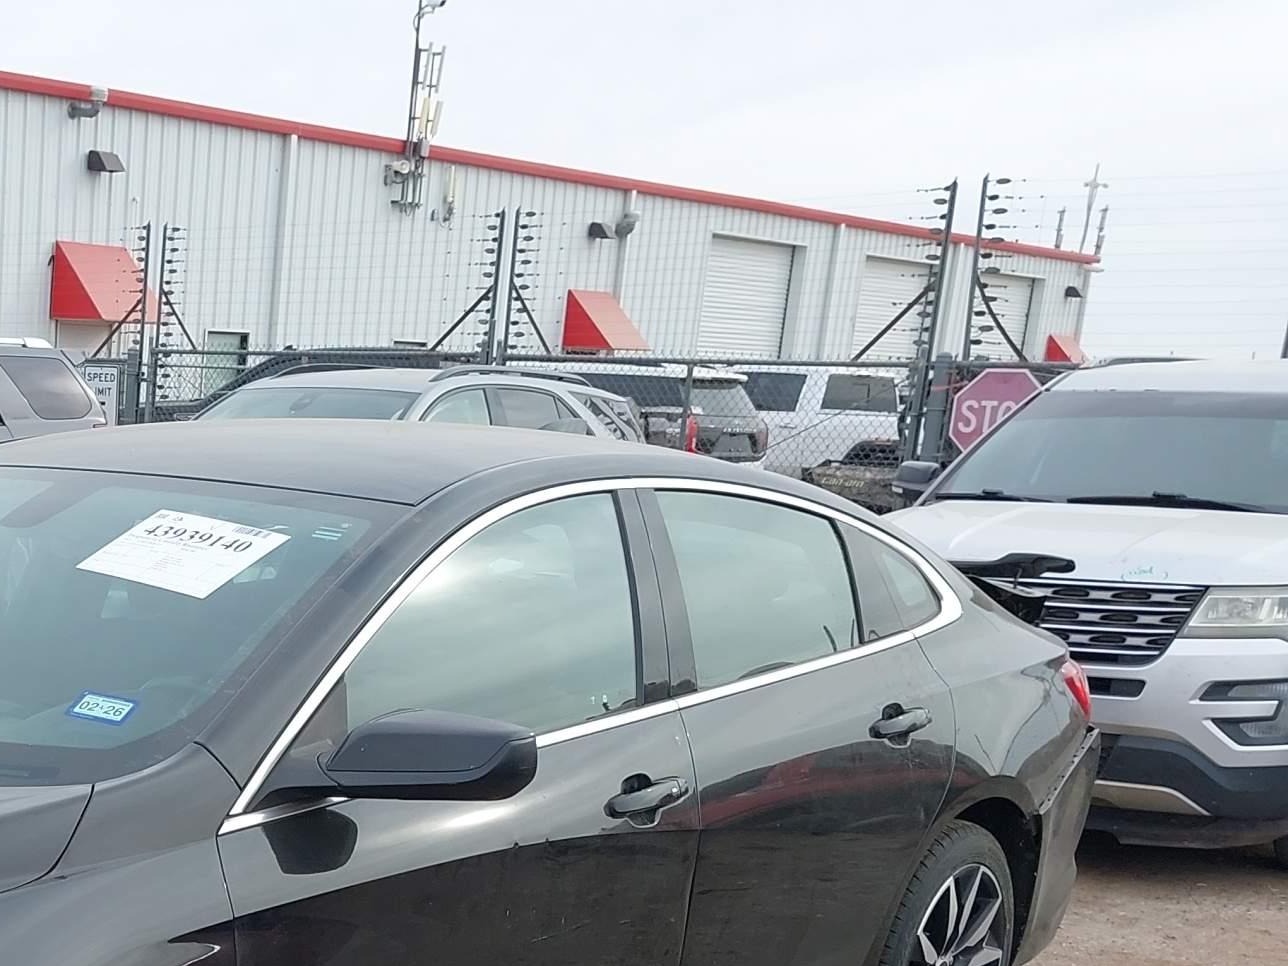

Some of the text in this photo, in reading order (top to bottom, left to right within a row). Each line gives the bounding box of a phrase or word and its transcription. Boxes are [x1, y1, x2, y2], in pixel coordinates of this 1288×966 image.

[86, 372, 116, 383] SPEED
[94, 386, 112, 397] IMIT
[143, 523, 254, 553] 43939140
